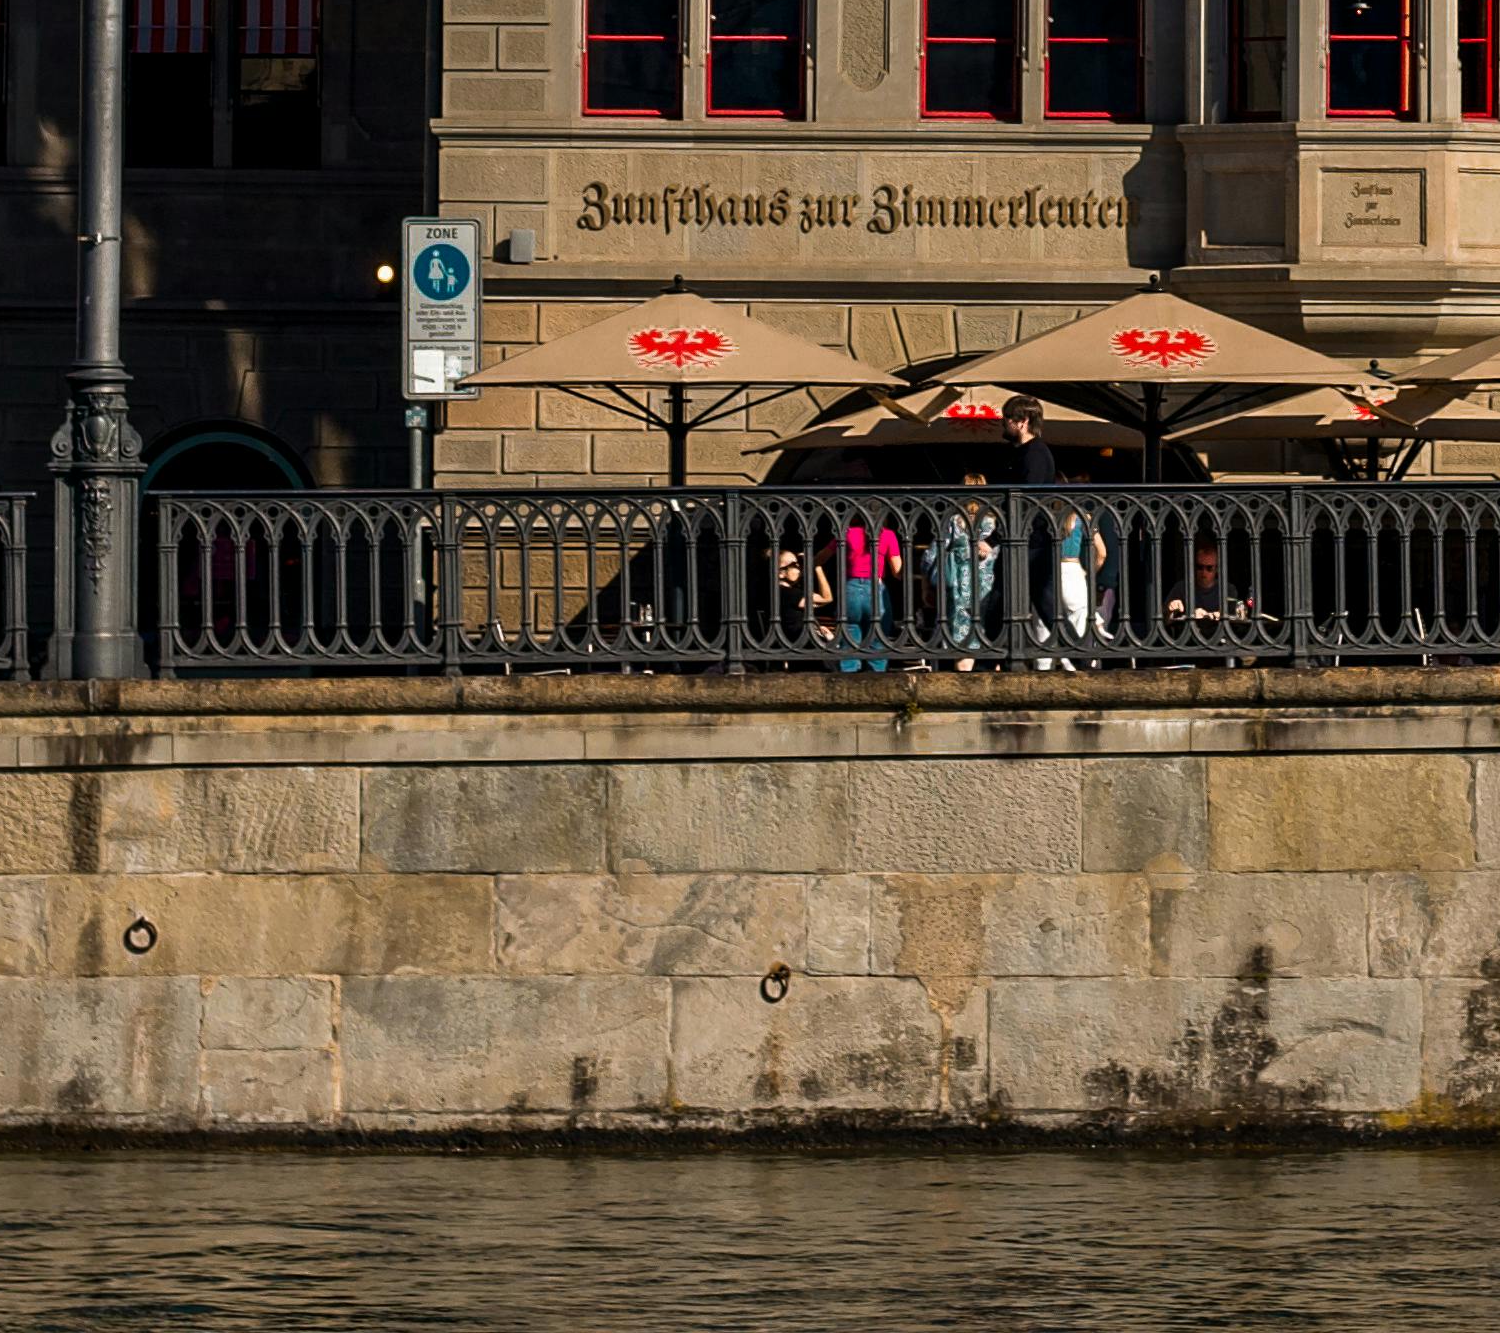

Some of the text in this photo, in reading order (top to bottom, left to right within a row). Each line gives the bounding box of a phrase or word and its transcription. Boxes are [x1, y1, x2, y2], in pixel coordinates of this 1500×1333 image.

[577, 181, 1141, 236] Zunfthaus zur Zimmerleuten
[426, 228, 458, 240] ZONE
